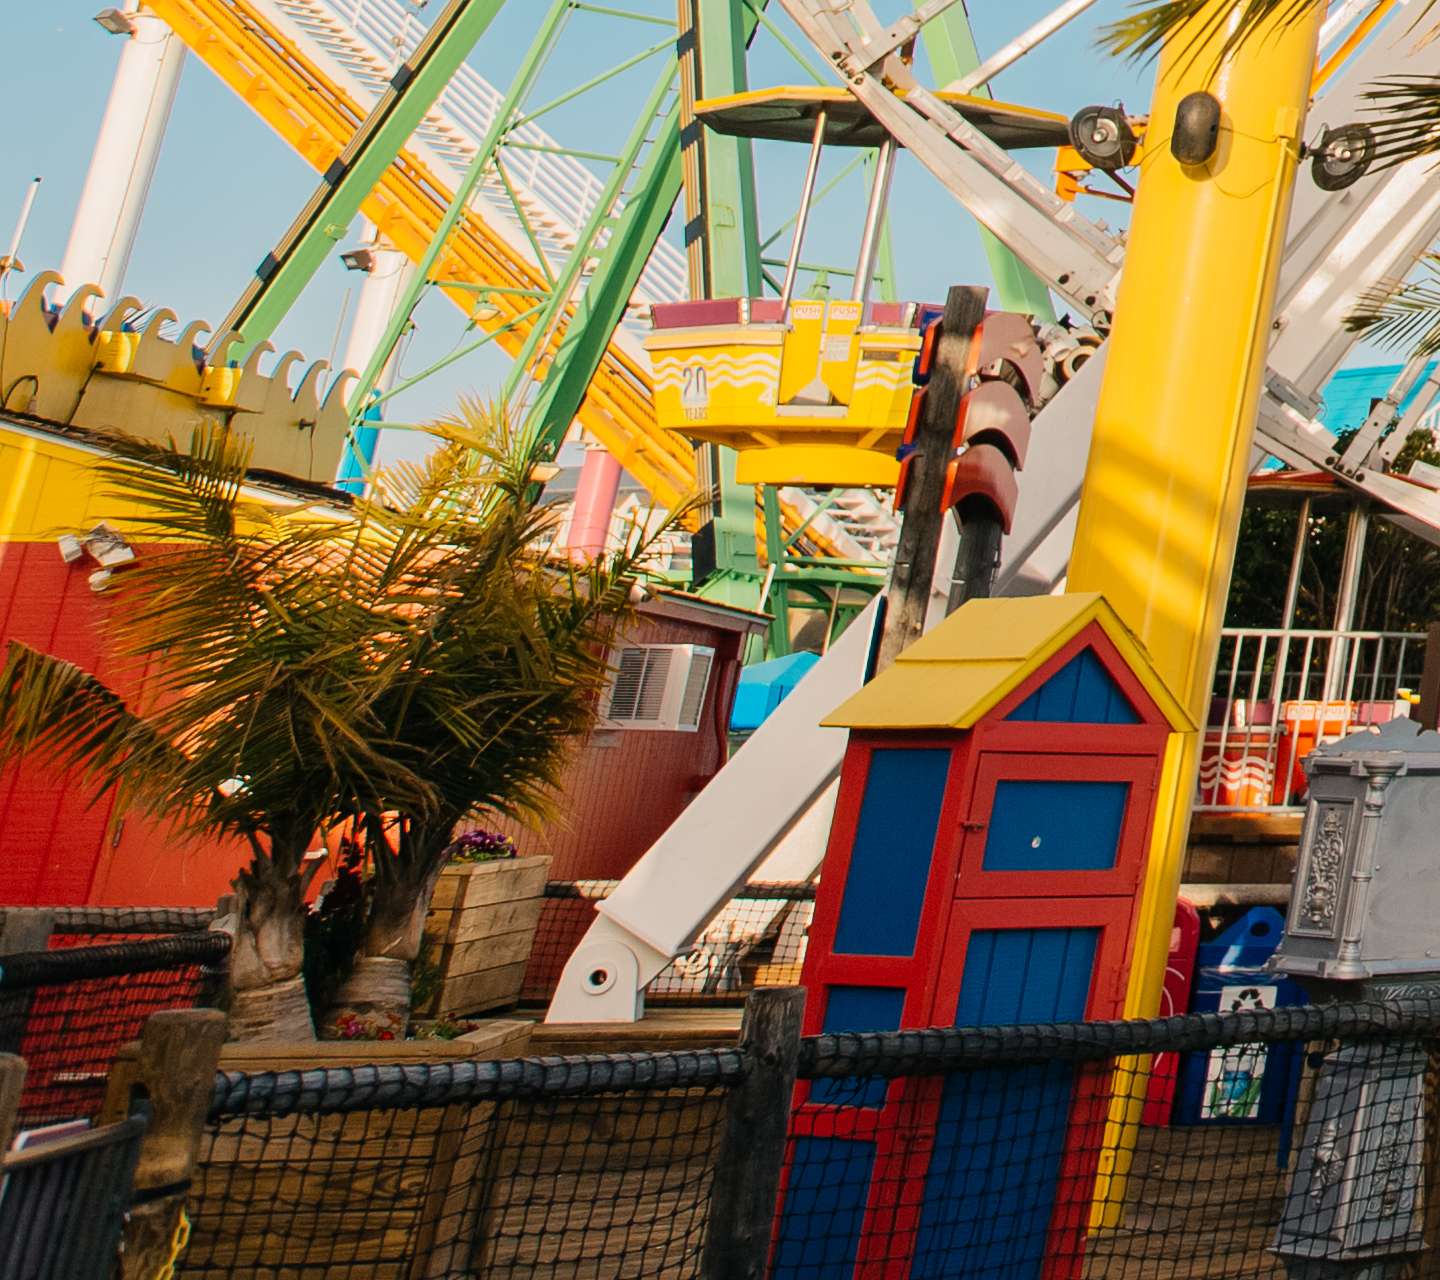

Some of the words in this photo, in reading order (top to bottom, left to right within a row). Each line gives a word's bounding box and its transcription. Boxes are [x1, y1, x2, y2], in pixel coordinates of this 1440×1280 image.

[796, 306, 821, 316] PUSH
[831, 306, 858, 316] PUSH
[758, 385, 774, 407] 4
